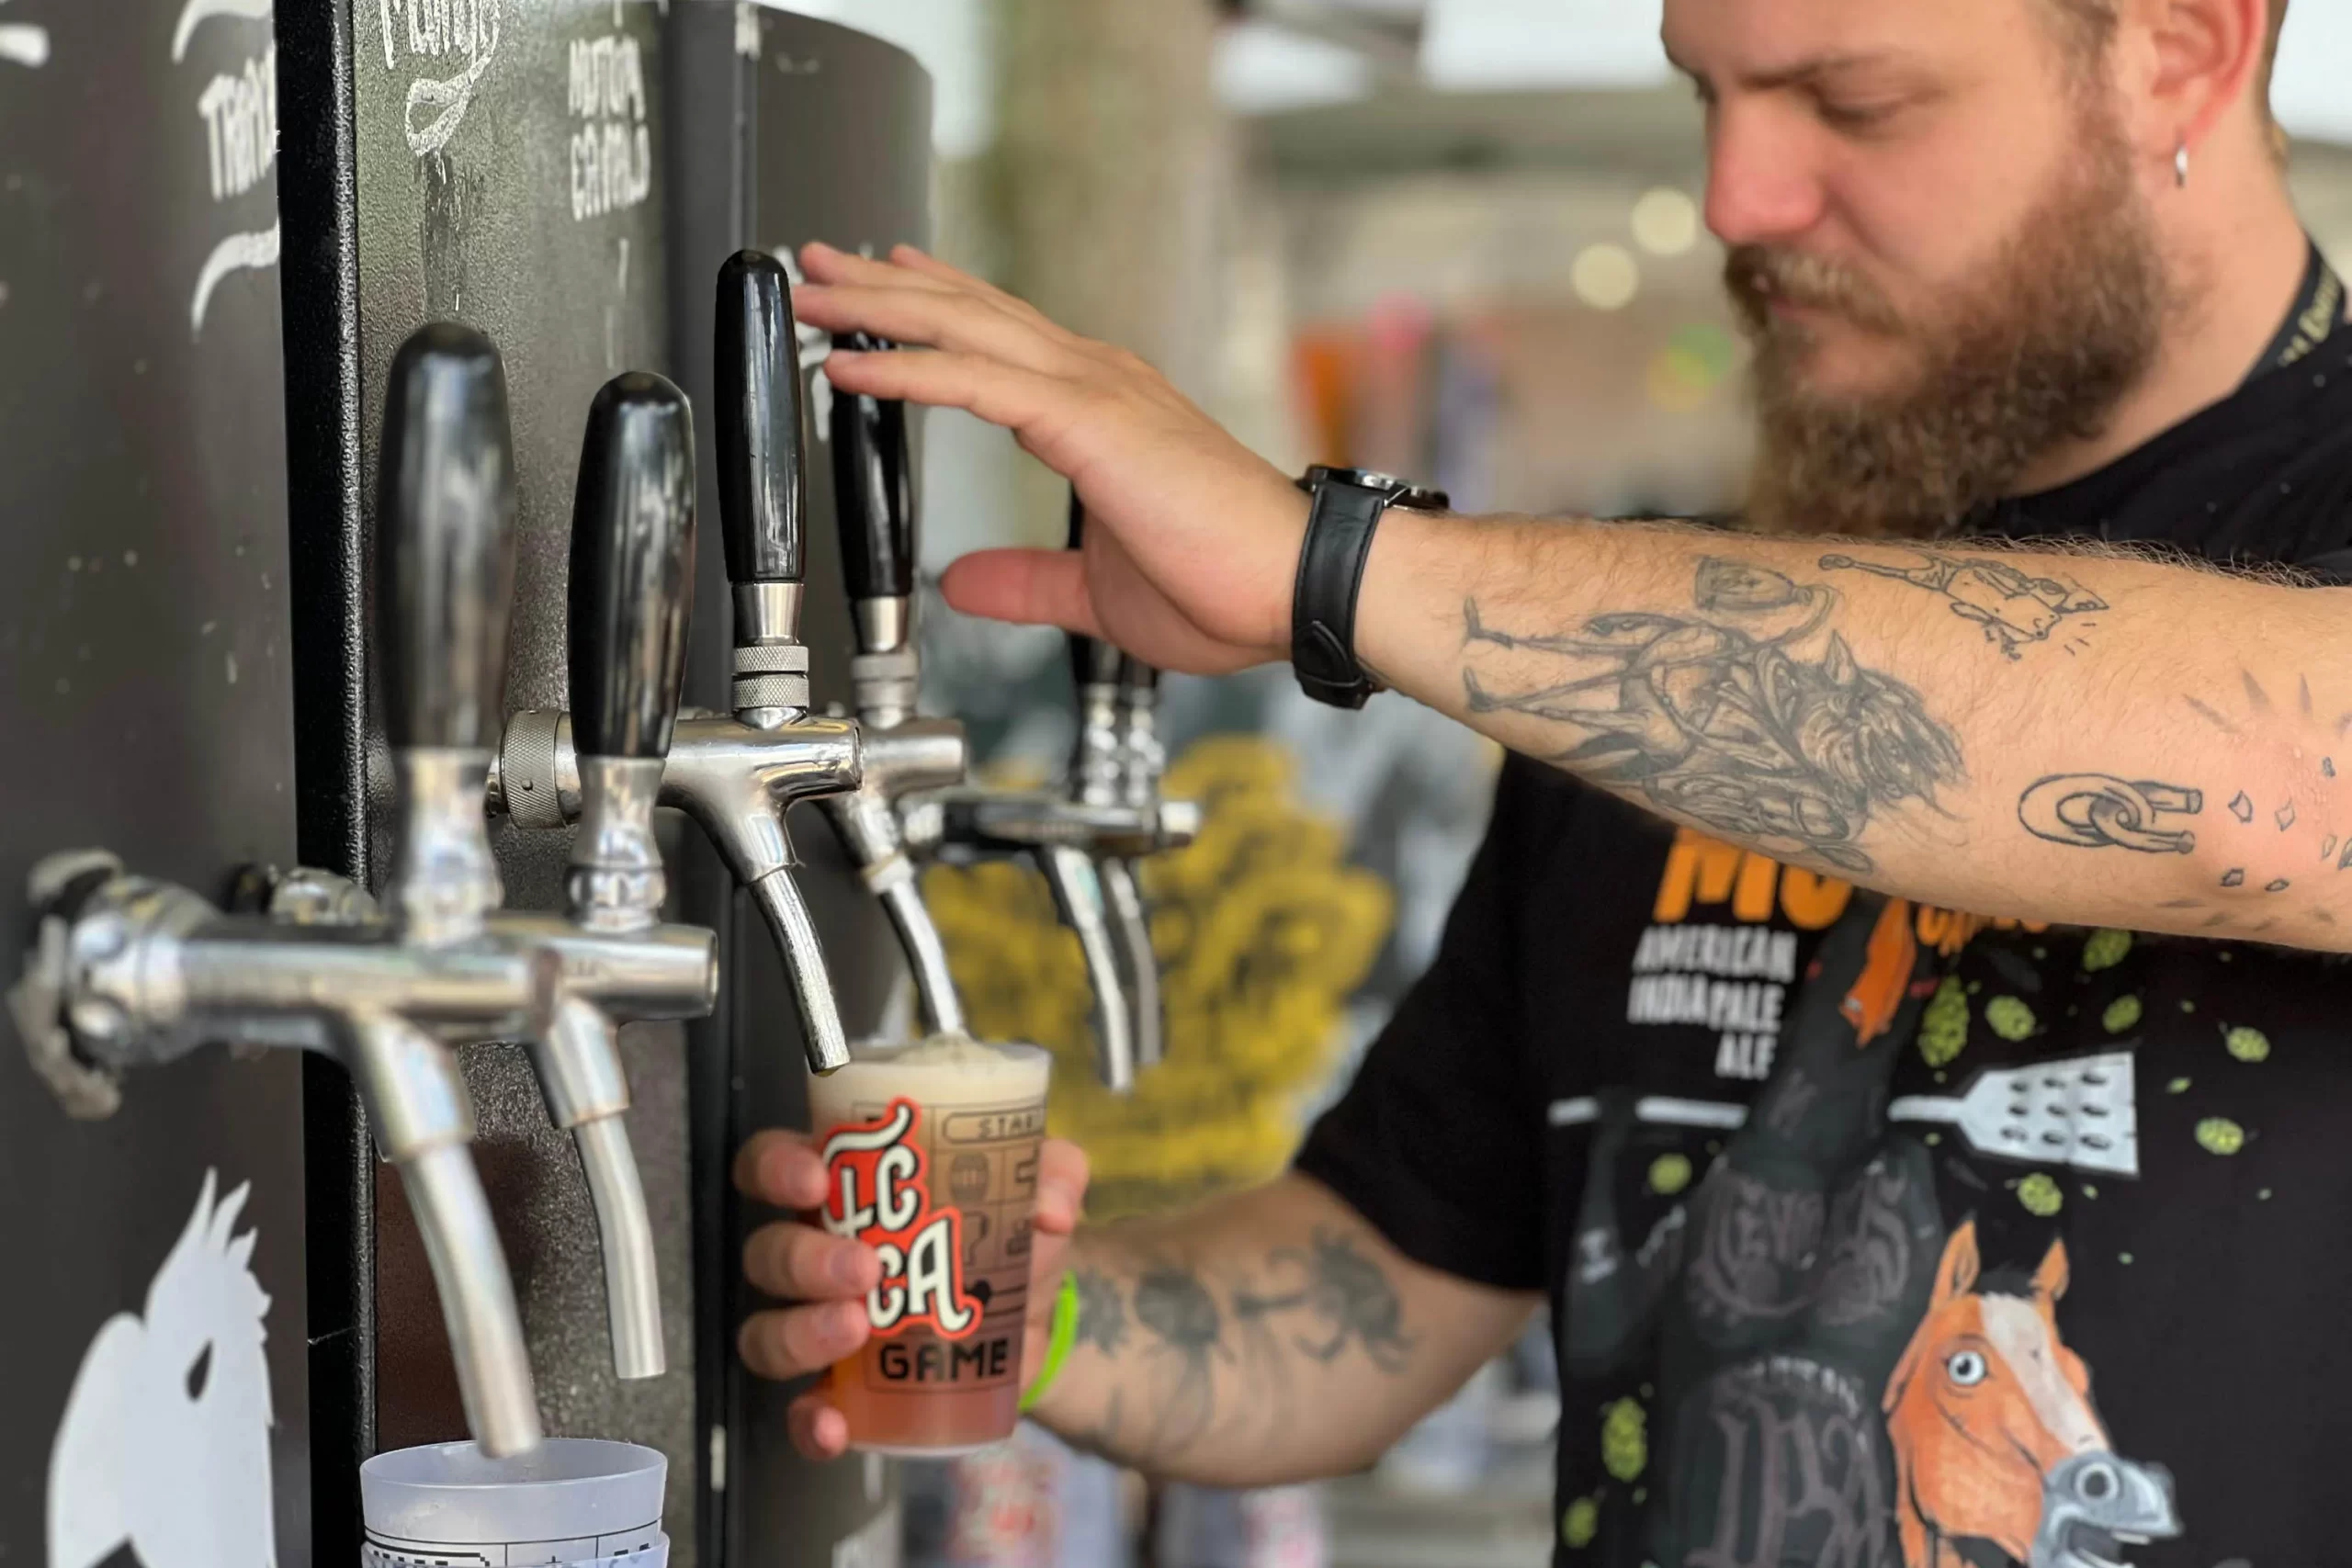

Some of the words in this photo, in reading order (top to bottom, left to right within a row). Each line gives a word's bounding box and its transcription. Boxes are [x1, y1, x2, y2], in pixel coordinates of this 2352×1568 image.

[1633, 922, 1797, 984] AMERICAN
[1626, 973, 1708, 1025] INDIA
[1708, 979, 1785, 1033] PALE
[1714, 1031, 1778, 1081] ALE
[879, 1337, 1009, 1382] GAME
